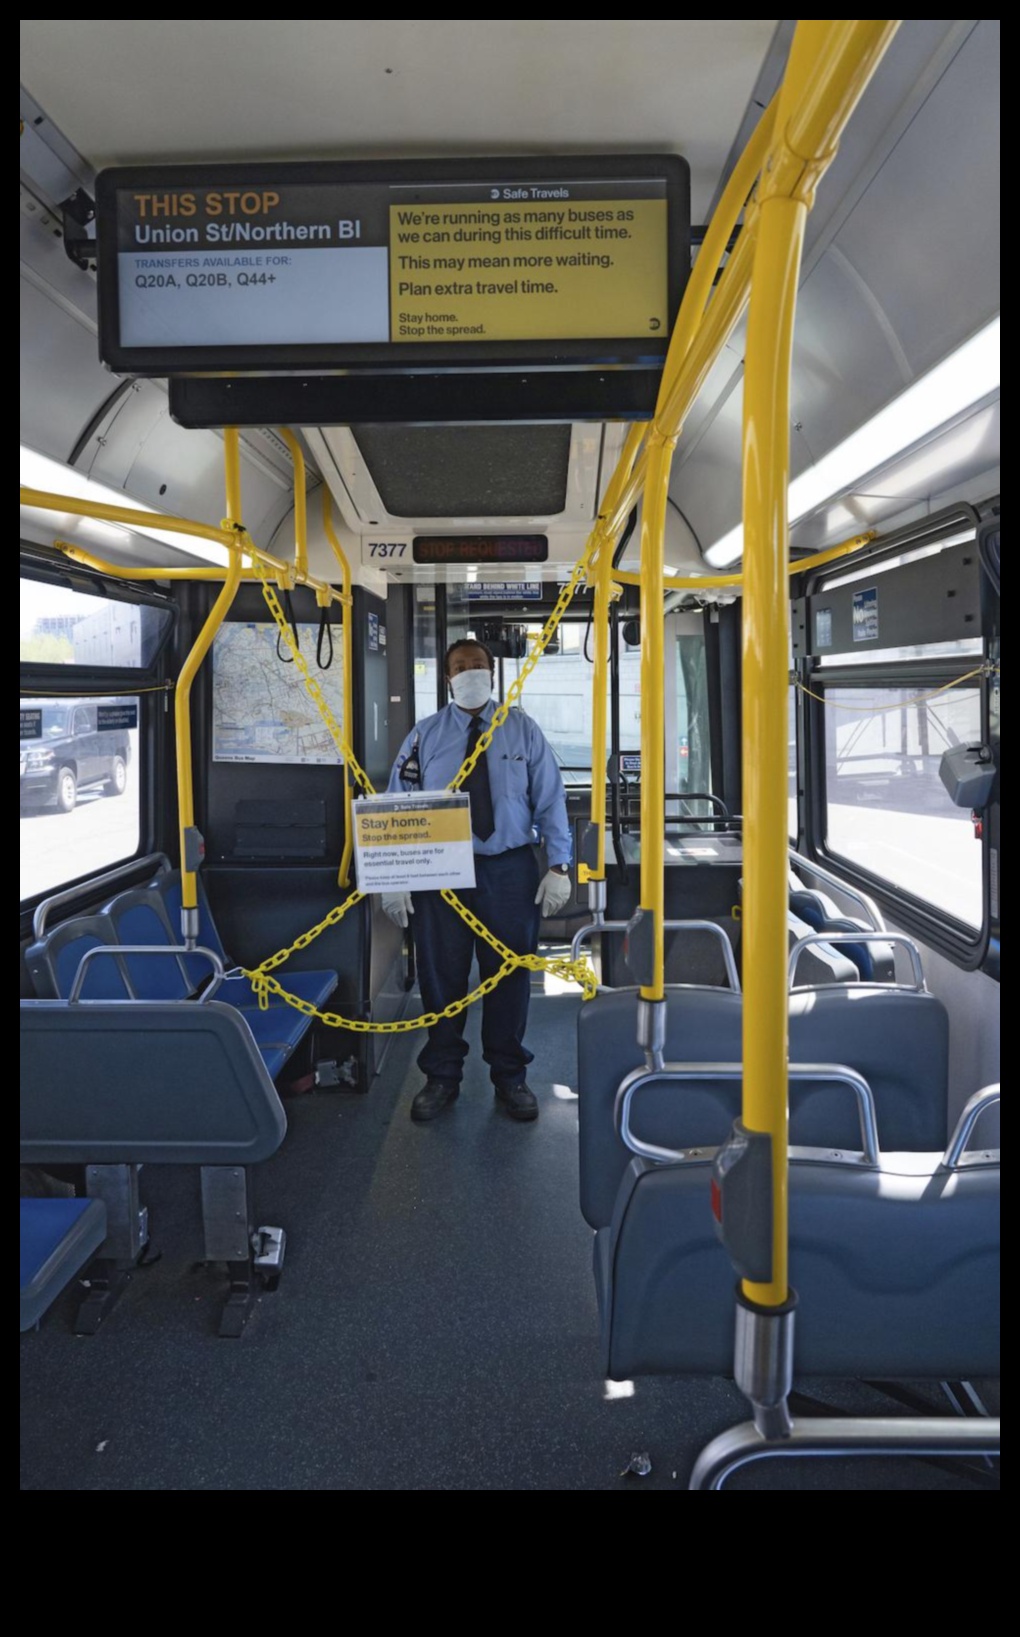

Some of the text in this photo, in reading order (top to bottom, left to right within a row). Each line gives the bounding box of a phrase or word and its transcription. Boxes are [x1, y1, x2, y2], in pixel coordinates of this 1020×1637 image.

[503, 188, 568, 199] Safe Travels
[134, 192, 280, 216] THIS STOP
[398, 209, 634, 226] We're running as many buses as
[135, 224, 198, 244] Union
[206, 222, 331, 242] St/Northern
[398, 226, 632, 244] we can during this difficult time.
[135, 256, 292, 269] TRANSFERS AVAILABLE FOR:
[398, 253, 614, 270] This may mean more waiting.
[135, 272, 276, 289] Q20A, Q20B, Q44+
[399, 280, 558, 296] Plan extra travel time.
[399, 313, 458, 324] Stay home.
[399, 324, 486, 336] Stop the spread.
[368, 543, 407, 558] 7377
[362, 818, 431, 830] Stay home.
[362, 834, 383, 842] Stop
[399, 832, 431, 841] spread.
